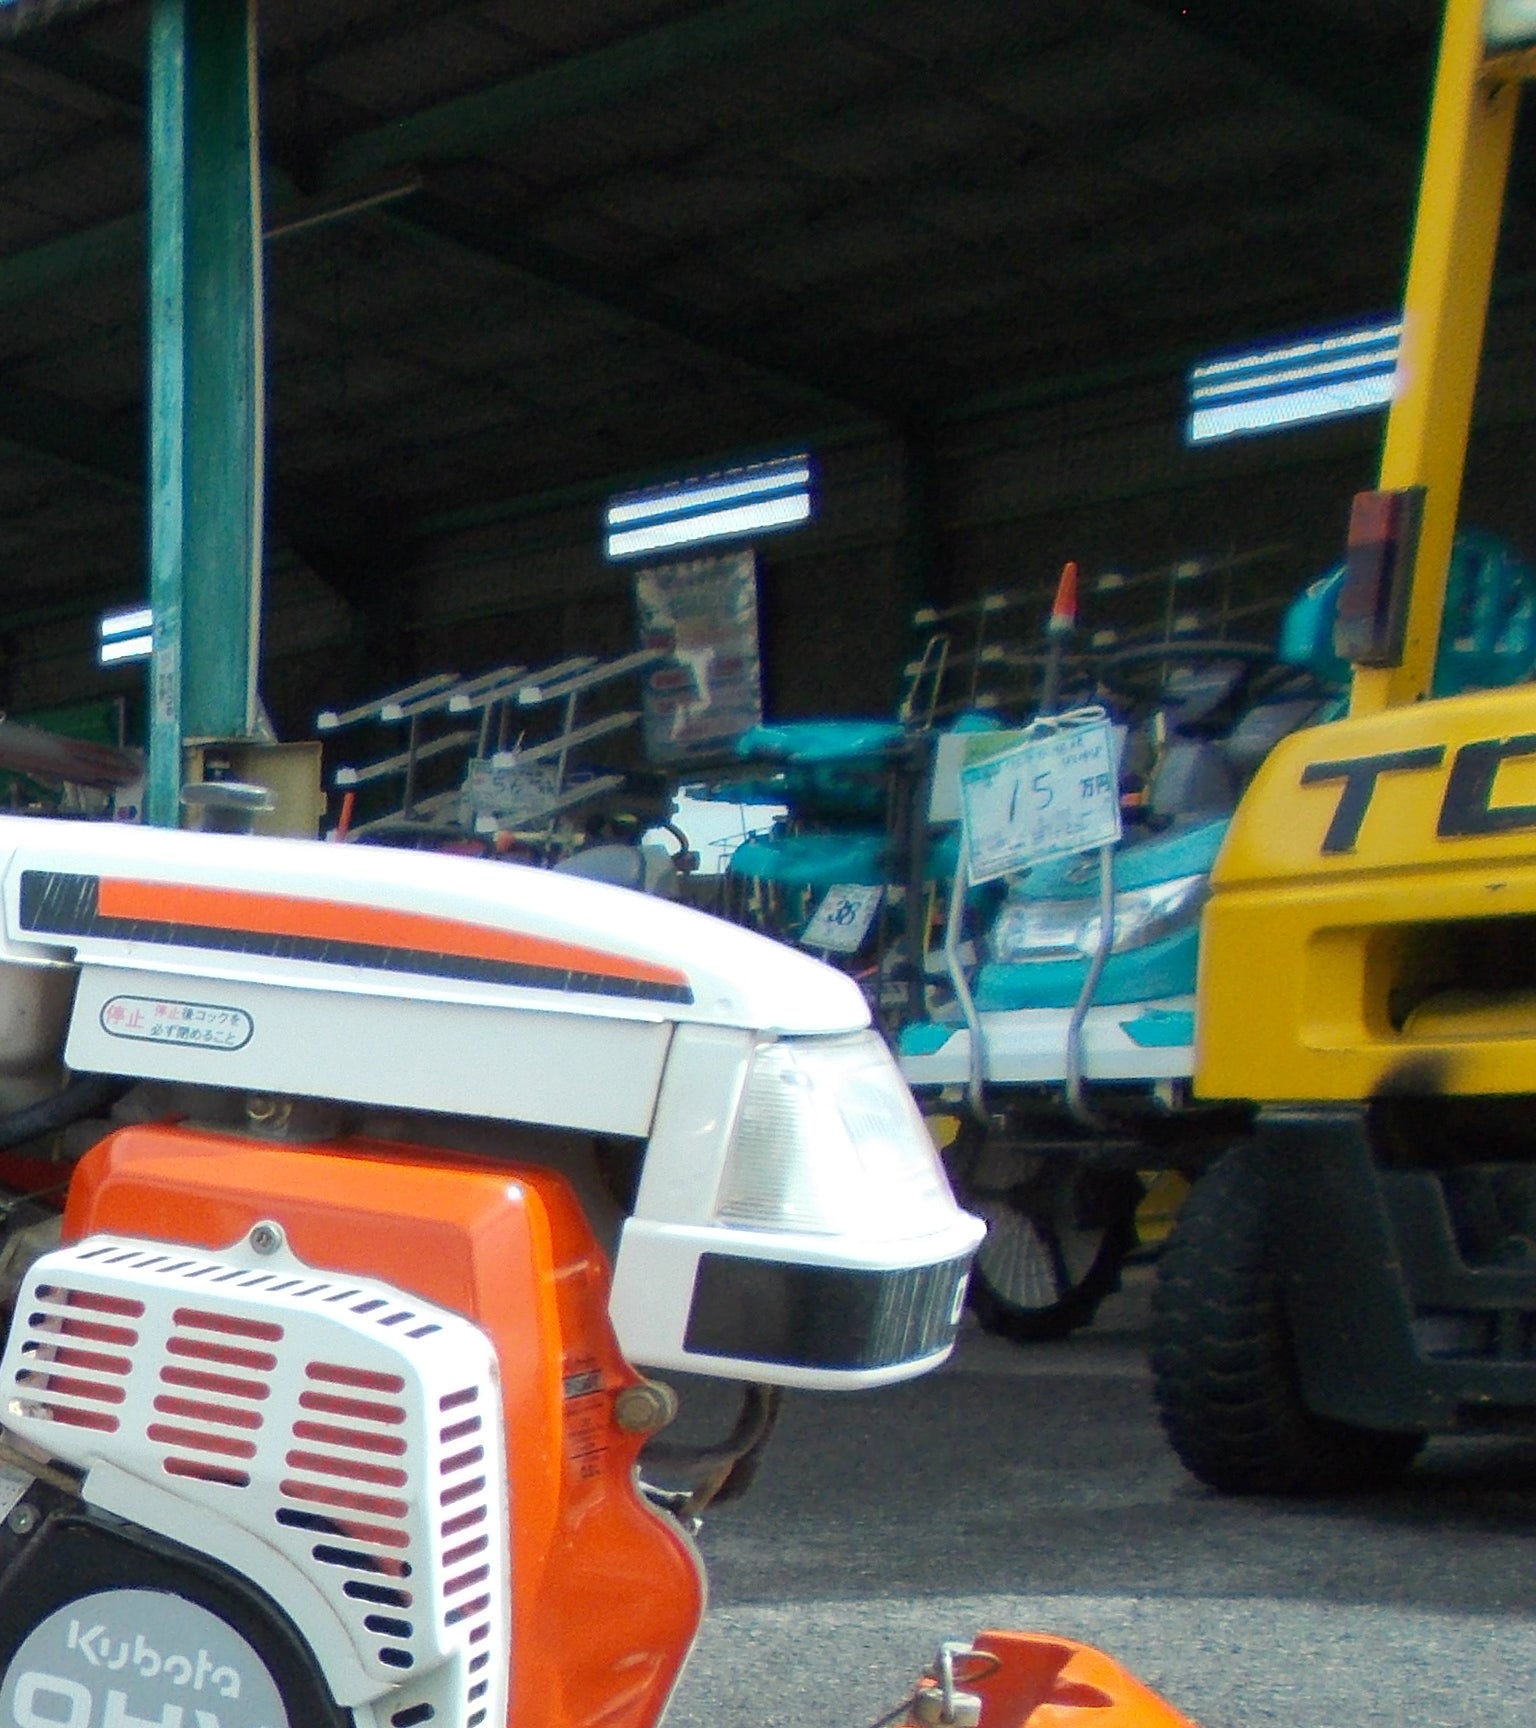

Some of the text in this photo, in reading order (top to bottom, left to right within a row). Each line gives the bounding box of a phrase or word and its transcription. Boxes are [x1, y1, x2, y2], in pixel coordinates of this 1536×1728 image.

[1009, 770, 1053, 823] 15
[106, 1004, 145, 1030] 停止
[66, 1619, 241, 1699] Kubota
